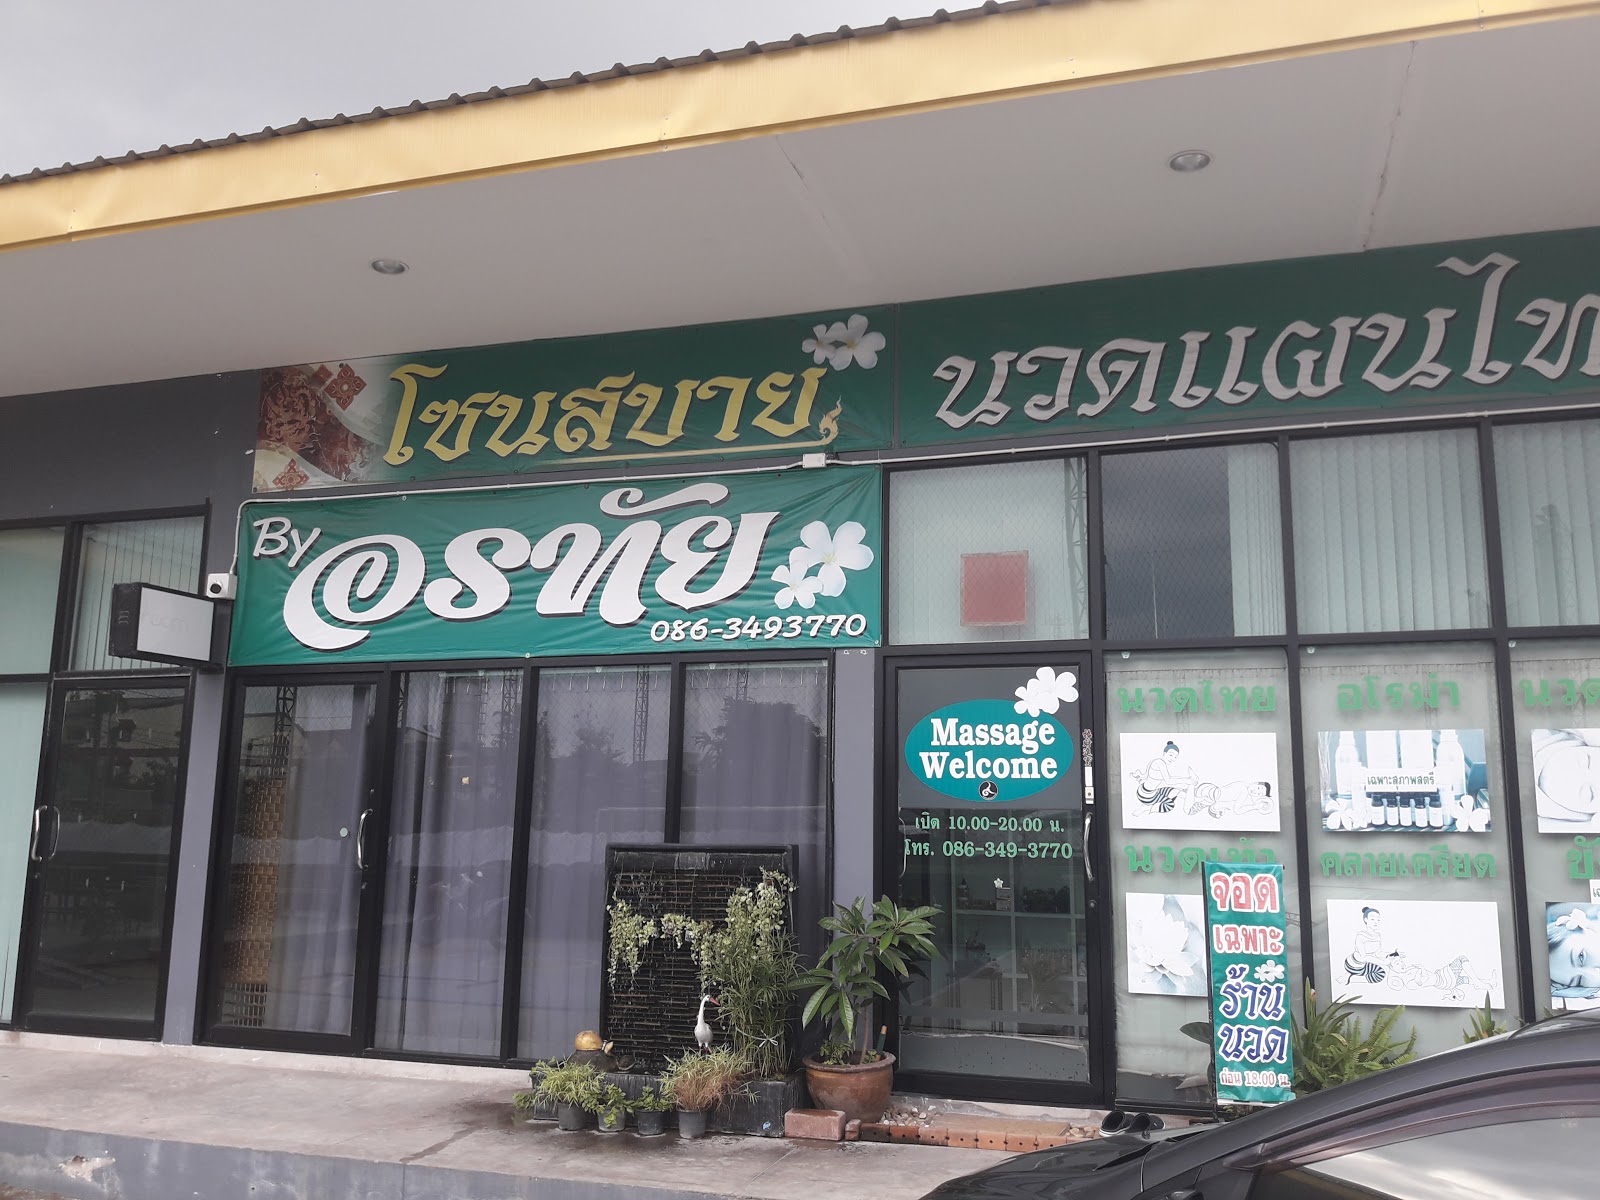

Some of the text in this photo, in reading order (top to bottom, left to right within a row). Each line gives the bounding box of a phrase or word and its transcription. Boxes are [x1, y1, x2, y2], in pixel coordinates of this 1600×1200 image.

[253, 516, 322, 570] By
[282, 481, 780, 652] อรทัย
[650, 613, 867, 642] 086-3493770
[1115, 678, 1278, 713] นวดไทย
[1337, 672, 1460, 711] อโรม่า
[930, 717, 1056, 754] Massage
[919, 750, 1058, 780] Welcome
[1367, 772, 1436, 791] เฉพาะสุภาพสตรี
[915, 812, 1065, 832] เปิด 10.00-20.00 น.
[905, 839, 1073, 859] โทร. 086-349-3770
[1320, 845, 1497, 879] คลายเครียด
[1210, 872, 1279, 913] จอด
[1213, 924, 1285, 955] เฉพาะ
[1219, 964, 1286, 1020] ร้าน
[1218, 1024, 1289, 1063] นวด
[1245, 1071, 1276, 1087] 18.00
[1279, 1073, 1291, 1087] น.
